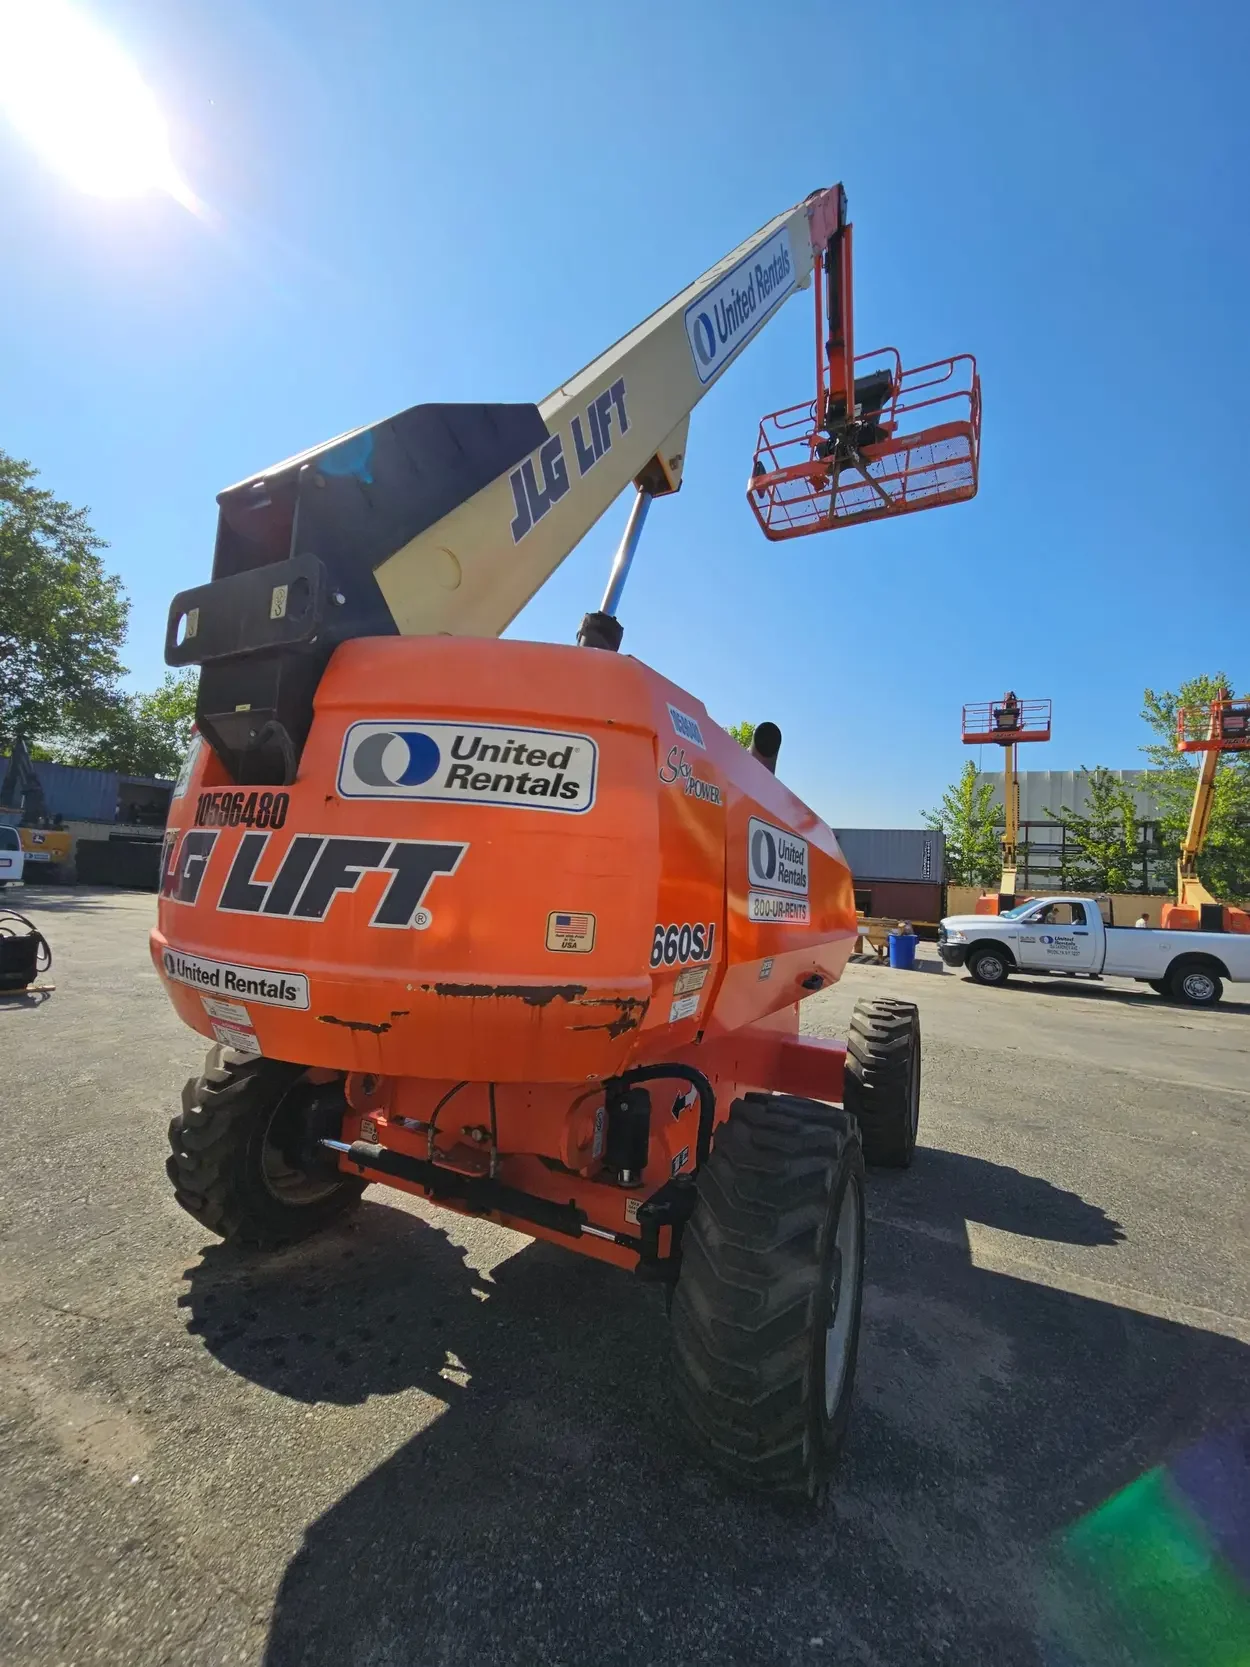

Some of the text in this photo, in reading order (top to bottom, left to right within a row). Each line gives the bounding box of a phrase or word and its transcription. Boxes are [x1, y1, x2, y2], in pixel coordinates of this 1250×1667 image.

[714, 243, 791, 344] United Rentals
[508, 375, 629, 546] JLG LIFT
[450, 735, 574, 770] United
[444, 763, 580, 800] Rentals
[659, 745, 720, 804] Sky POWER
[193, 791, 290, 830] 10596480
[777, 838, 805, 866] United
[158, 828, 471, 930] LG LIFT
[777, 861, 807, 888] Rentals
[753, 898, 807, 920] 800-UR-RENTS
[561, 941, 577, 949] USA
[649, 923, 715, 968] 660SJ
[176, 957, 297, 1001] United Rentals
